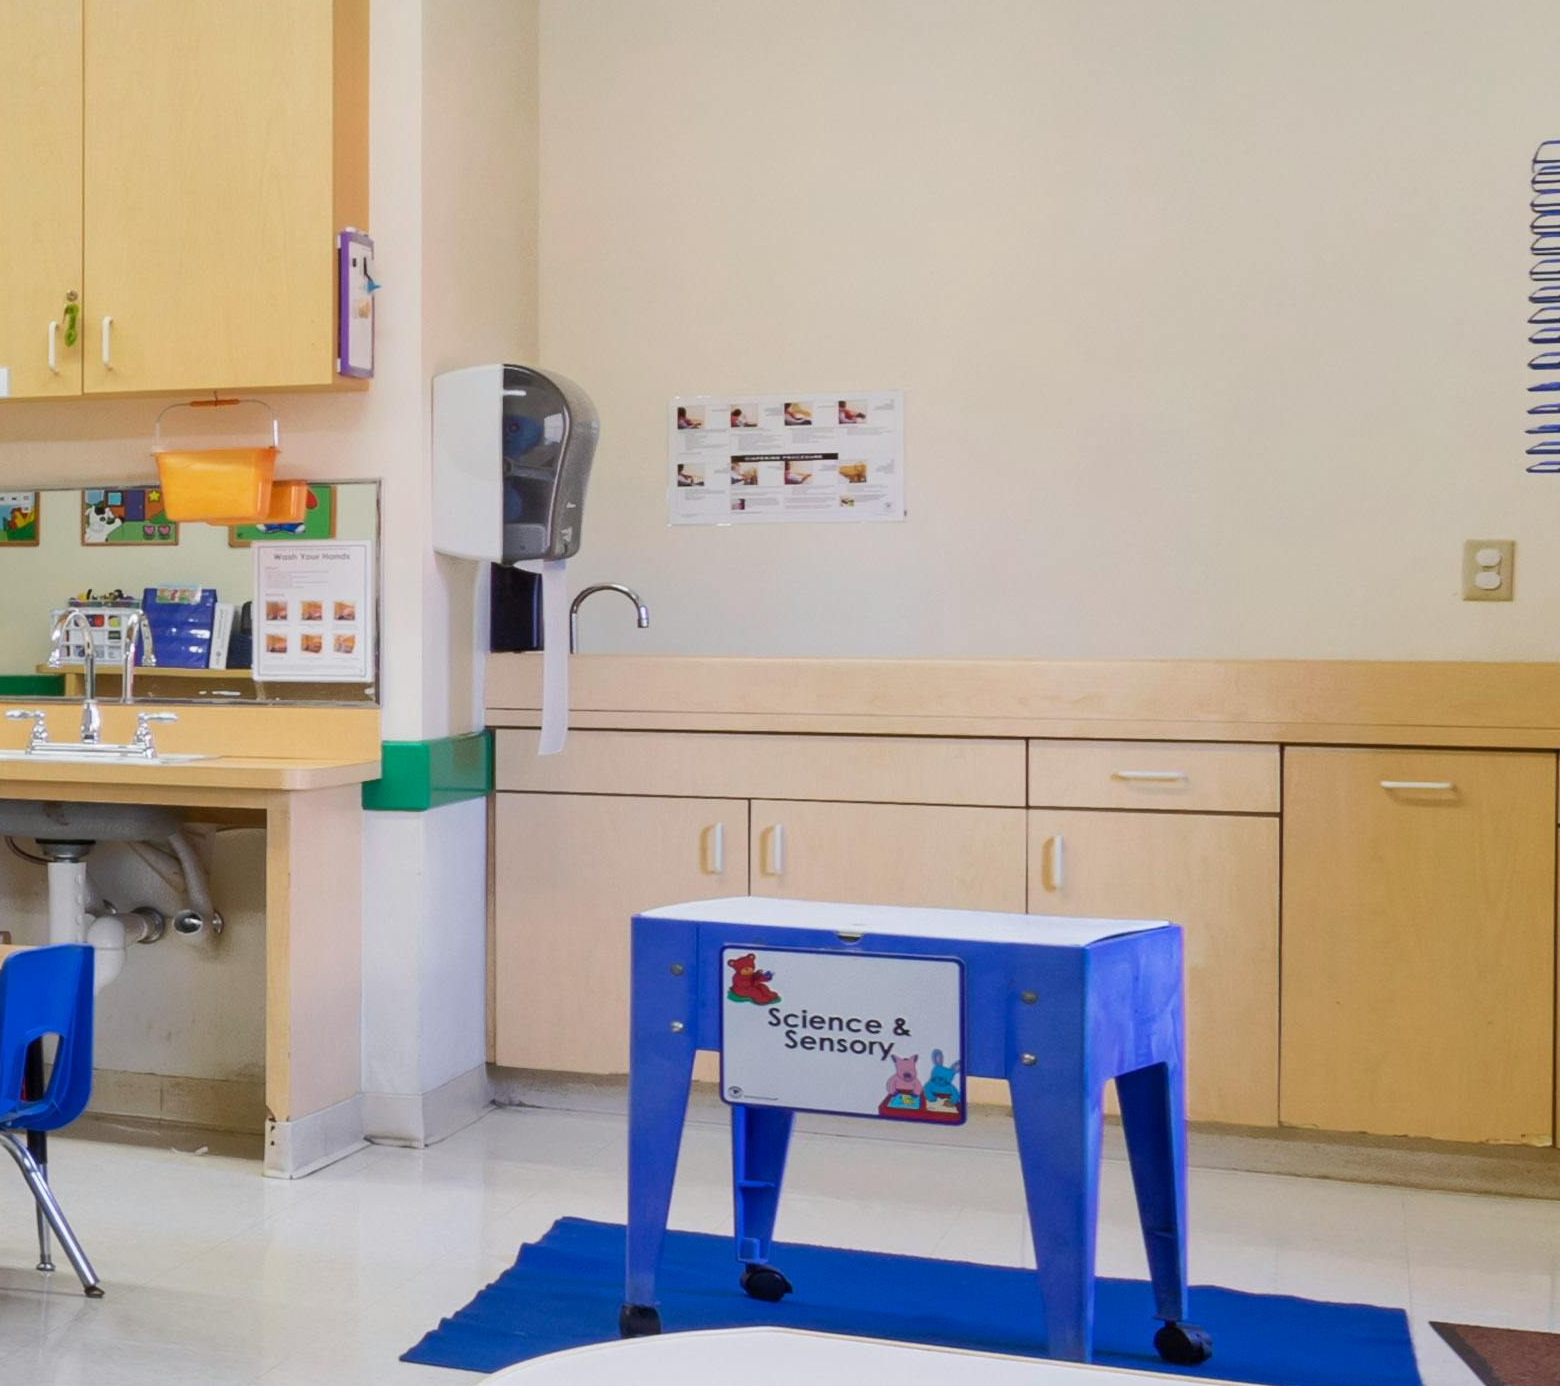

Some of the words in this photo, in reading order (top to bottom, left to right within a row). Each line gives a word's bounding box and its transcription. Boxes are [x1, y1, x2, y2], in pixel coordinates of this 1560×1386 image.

[273, 553, 298, 561] Wash
[300, 553, 320, 561] Your
[322, 552, 351, 560] Hands
[767, 1007, 883, 1035] Science
[893, 1017, 912, 1038] &
[784, 1030, 895, 1062] Sensory
